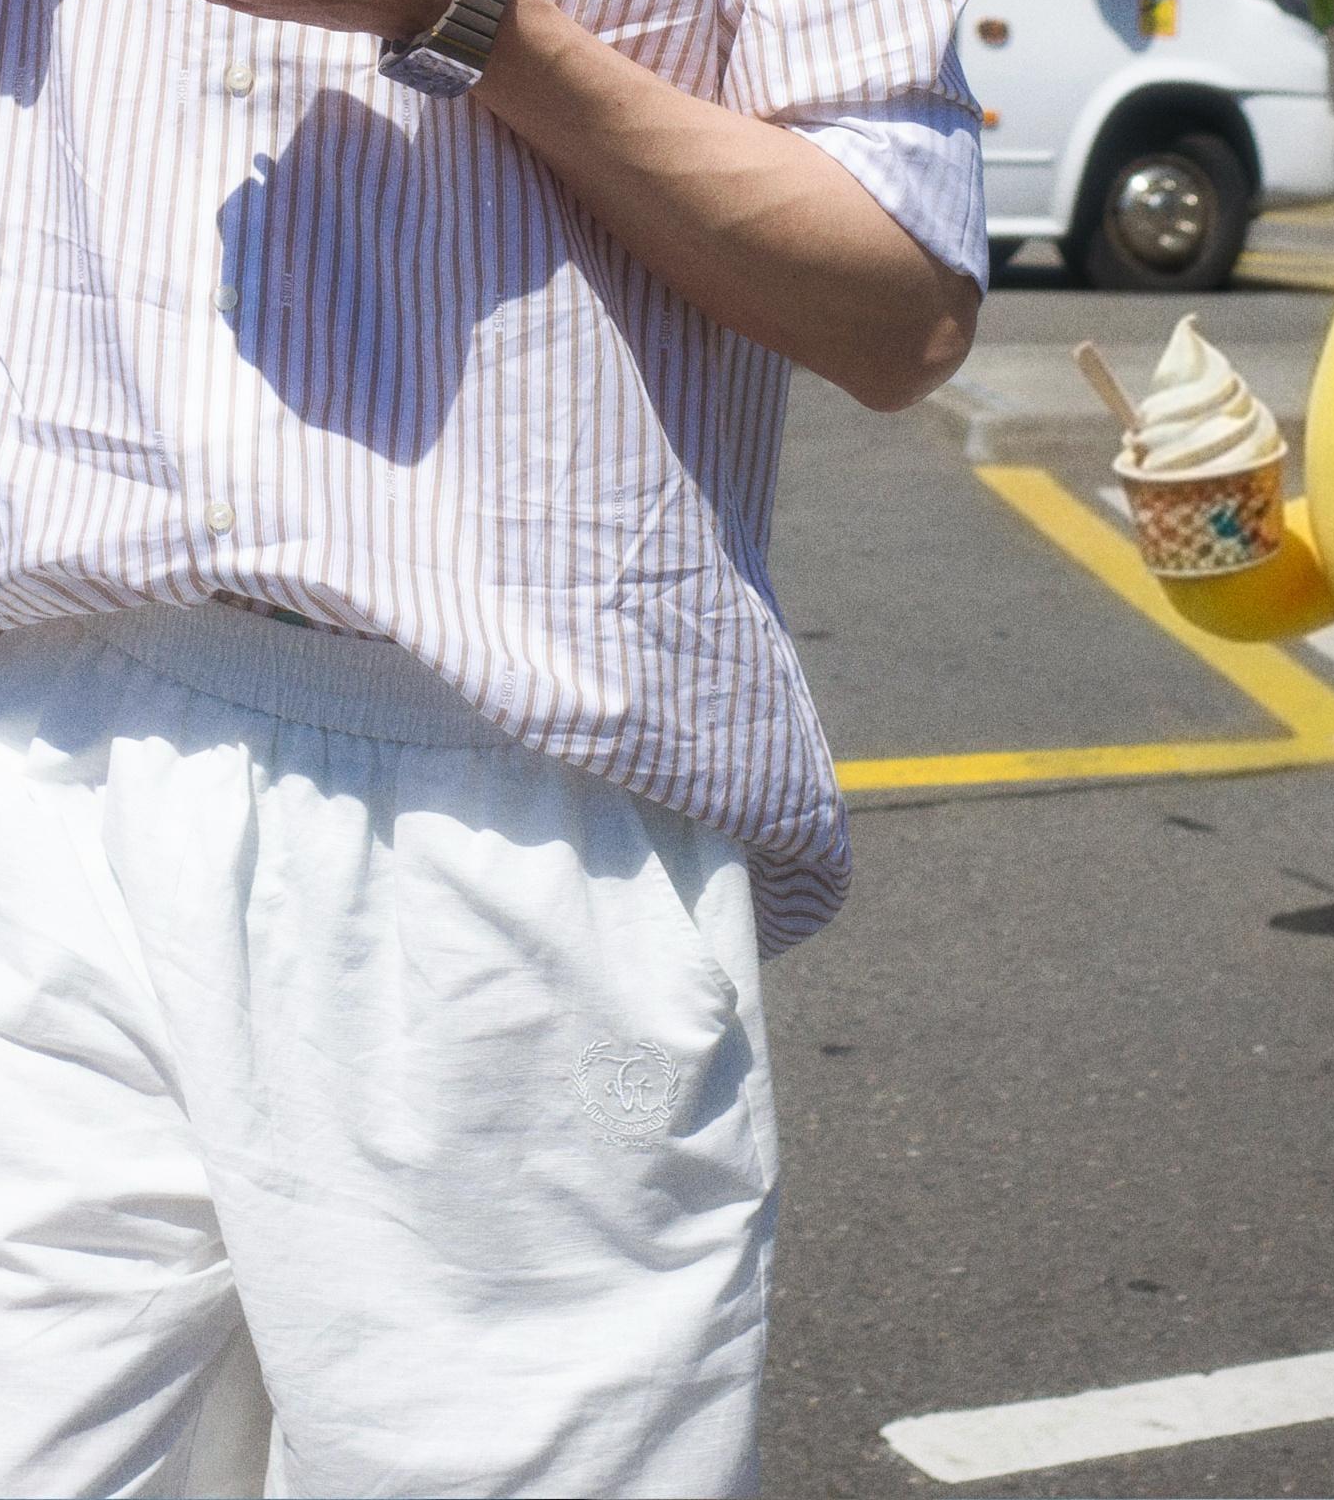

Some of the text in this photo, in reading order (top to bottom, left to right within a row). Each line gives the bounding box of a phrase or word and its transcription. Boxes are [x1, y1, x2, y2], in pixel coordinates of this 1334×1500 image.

[177, 72, 190, 101] KORS
[614, 490, 624, 519] KORS
[500, 673, 516, 706] KORS
